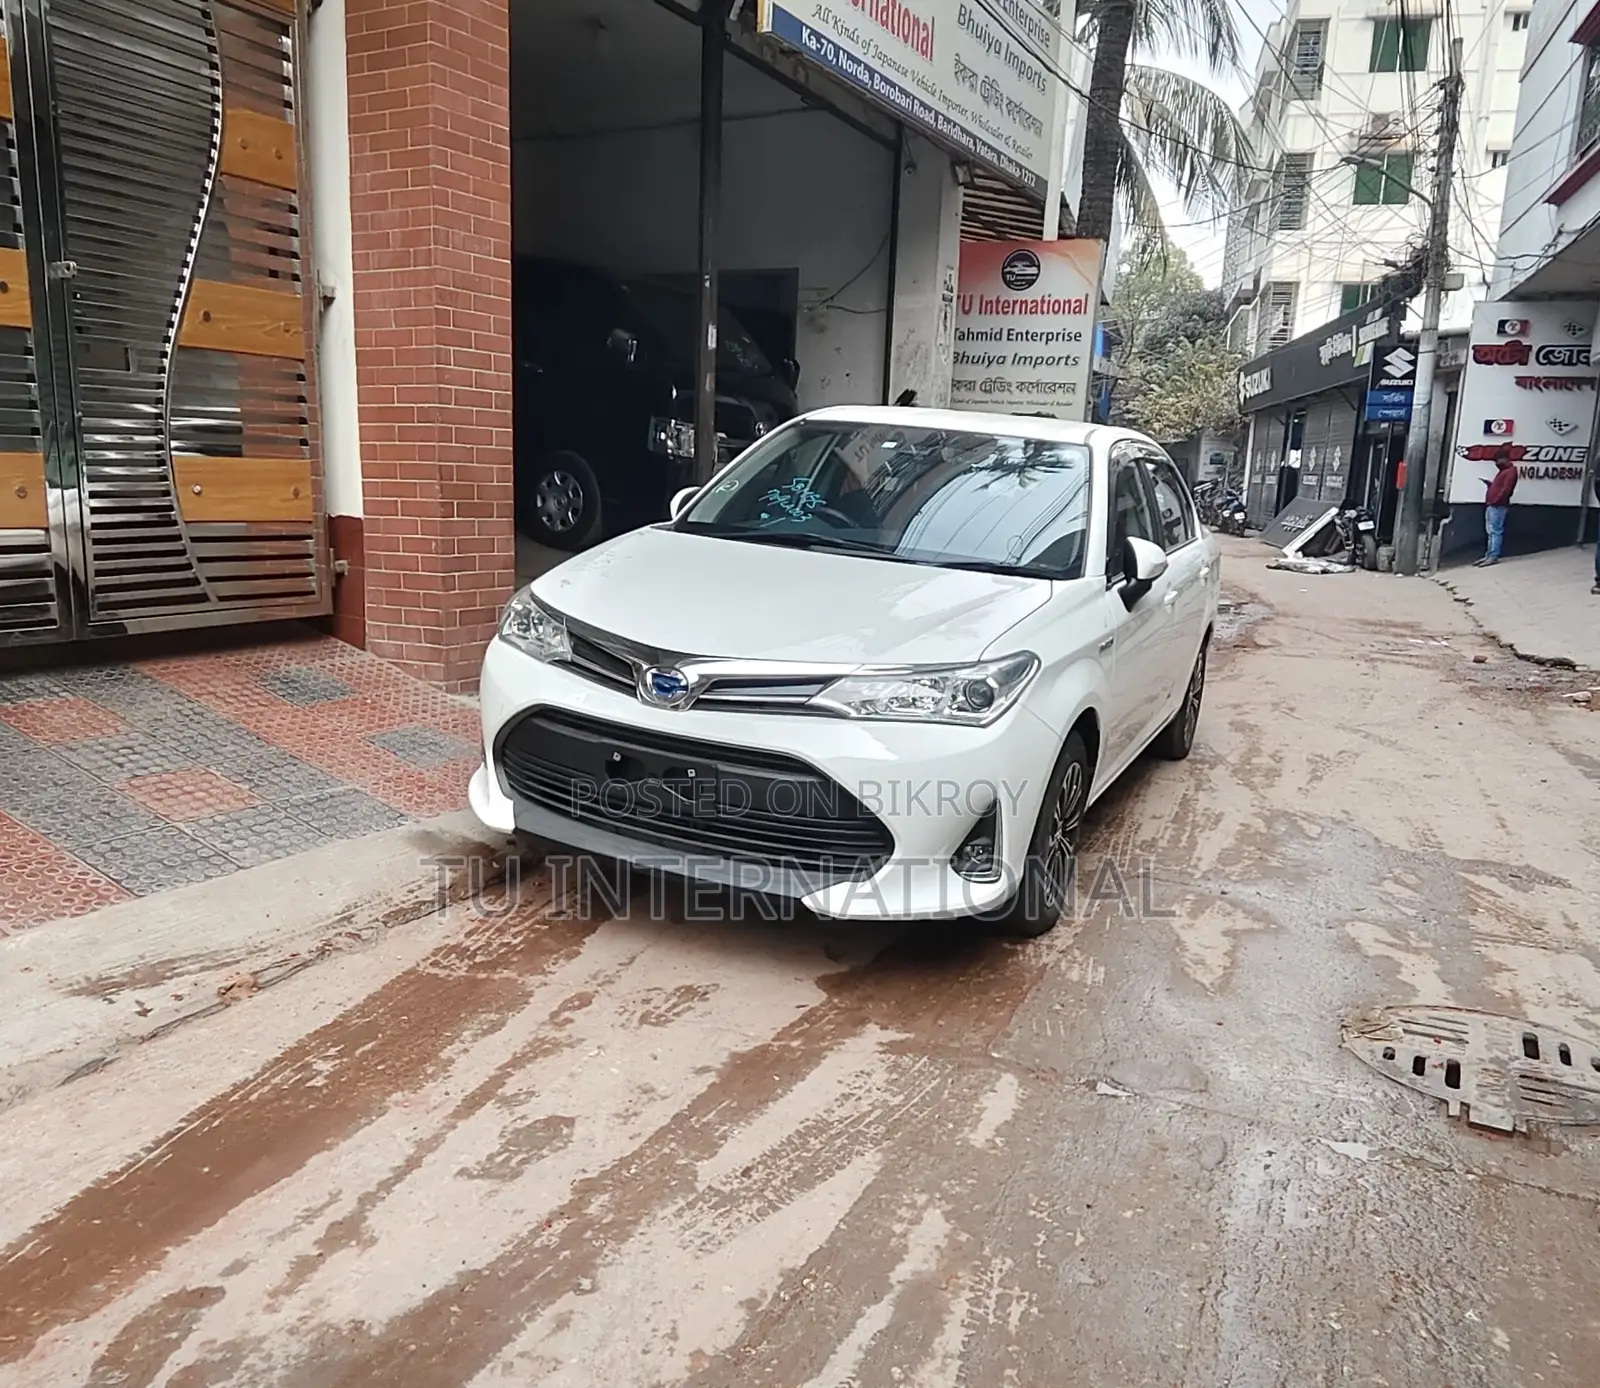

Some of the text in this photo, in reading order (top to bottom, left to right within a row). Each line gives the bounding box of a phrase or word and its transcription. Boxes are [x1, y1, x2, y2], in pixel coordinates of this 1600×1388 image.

[812, 4, 830, 24] All
[831, 15, 860, 45] Kinds
[861, 38, 874, 55] of
[872, 44, 909, 78] Japanese
[957, 3, 1047, 92] Bhuiya Imports
[802, 25, 837, 66] Ka-70,
[838, 50, 872, 88] Norda,
[873, 72, 913, 111] Borobari
[914, 98, 937, 128] Road,
[938, 116, 976, 154] Baridhara,
[979, 293, 1089, 316] International
[954, 327, 1082, 345] Tahmid Enterprise
[953, 351, 1080, 369] Bhuiya Imports
[952, 378, 976, 394] করা
[1519, 466, 1583, 481] NGLADESH
